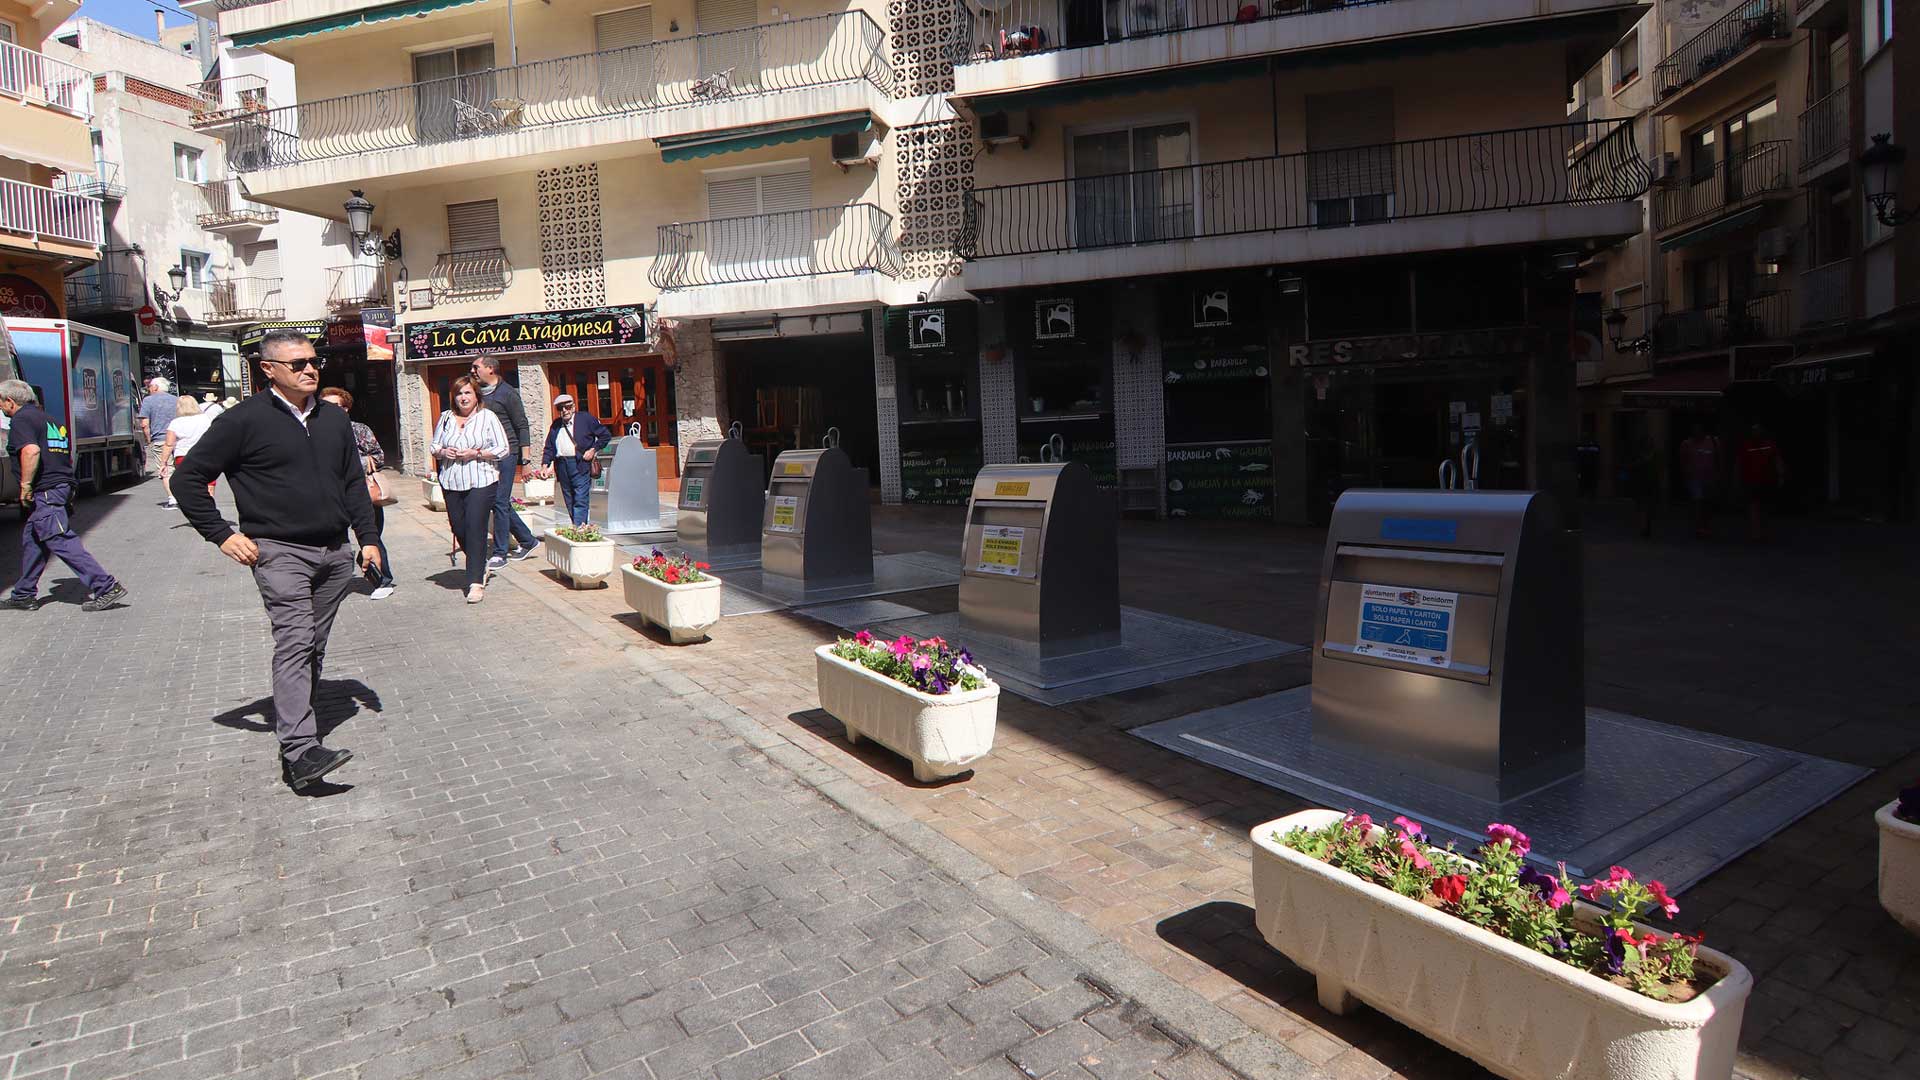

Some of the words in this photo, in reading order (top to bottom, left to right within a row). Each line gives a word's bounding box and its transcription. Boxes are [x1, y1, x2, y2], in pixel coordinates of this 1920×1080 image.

[432, 331, 456, 348] La
[460, 327, 511, 346] Cava
[516, 319, 614, 343] Aragonesa
[433, 349, 457, 358] TAPAS
[464, 345, 506, 356] CERVEZAS
[513, 343, 536, 352] BEERS
[543, 340, 570, 350] VINOS
[578, 337, 614, 348] WINERY
[1167, 449, 1211, 462] BARBADILLO
[1364, 590, 1395, 599] ajuntament
[1422, 595, 1454, 604] benidorm
[1371, 605, 1388, 613] SOLO
[1388, 606, 1408, 615] PAPEL
[1390, 616, 1411, 625] PAPER
